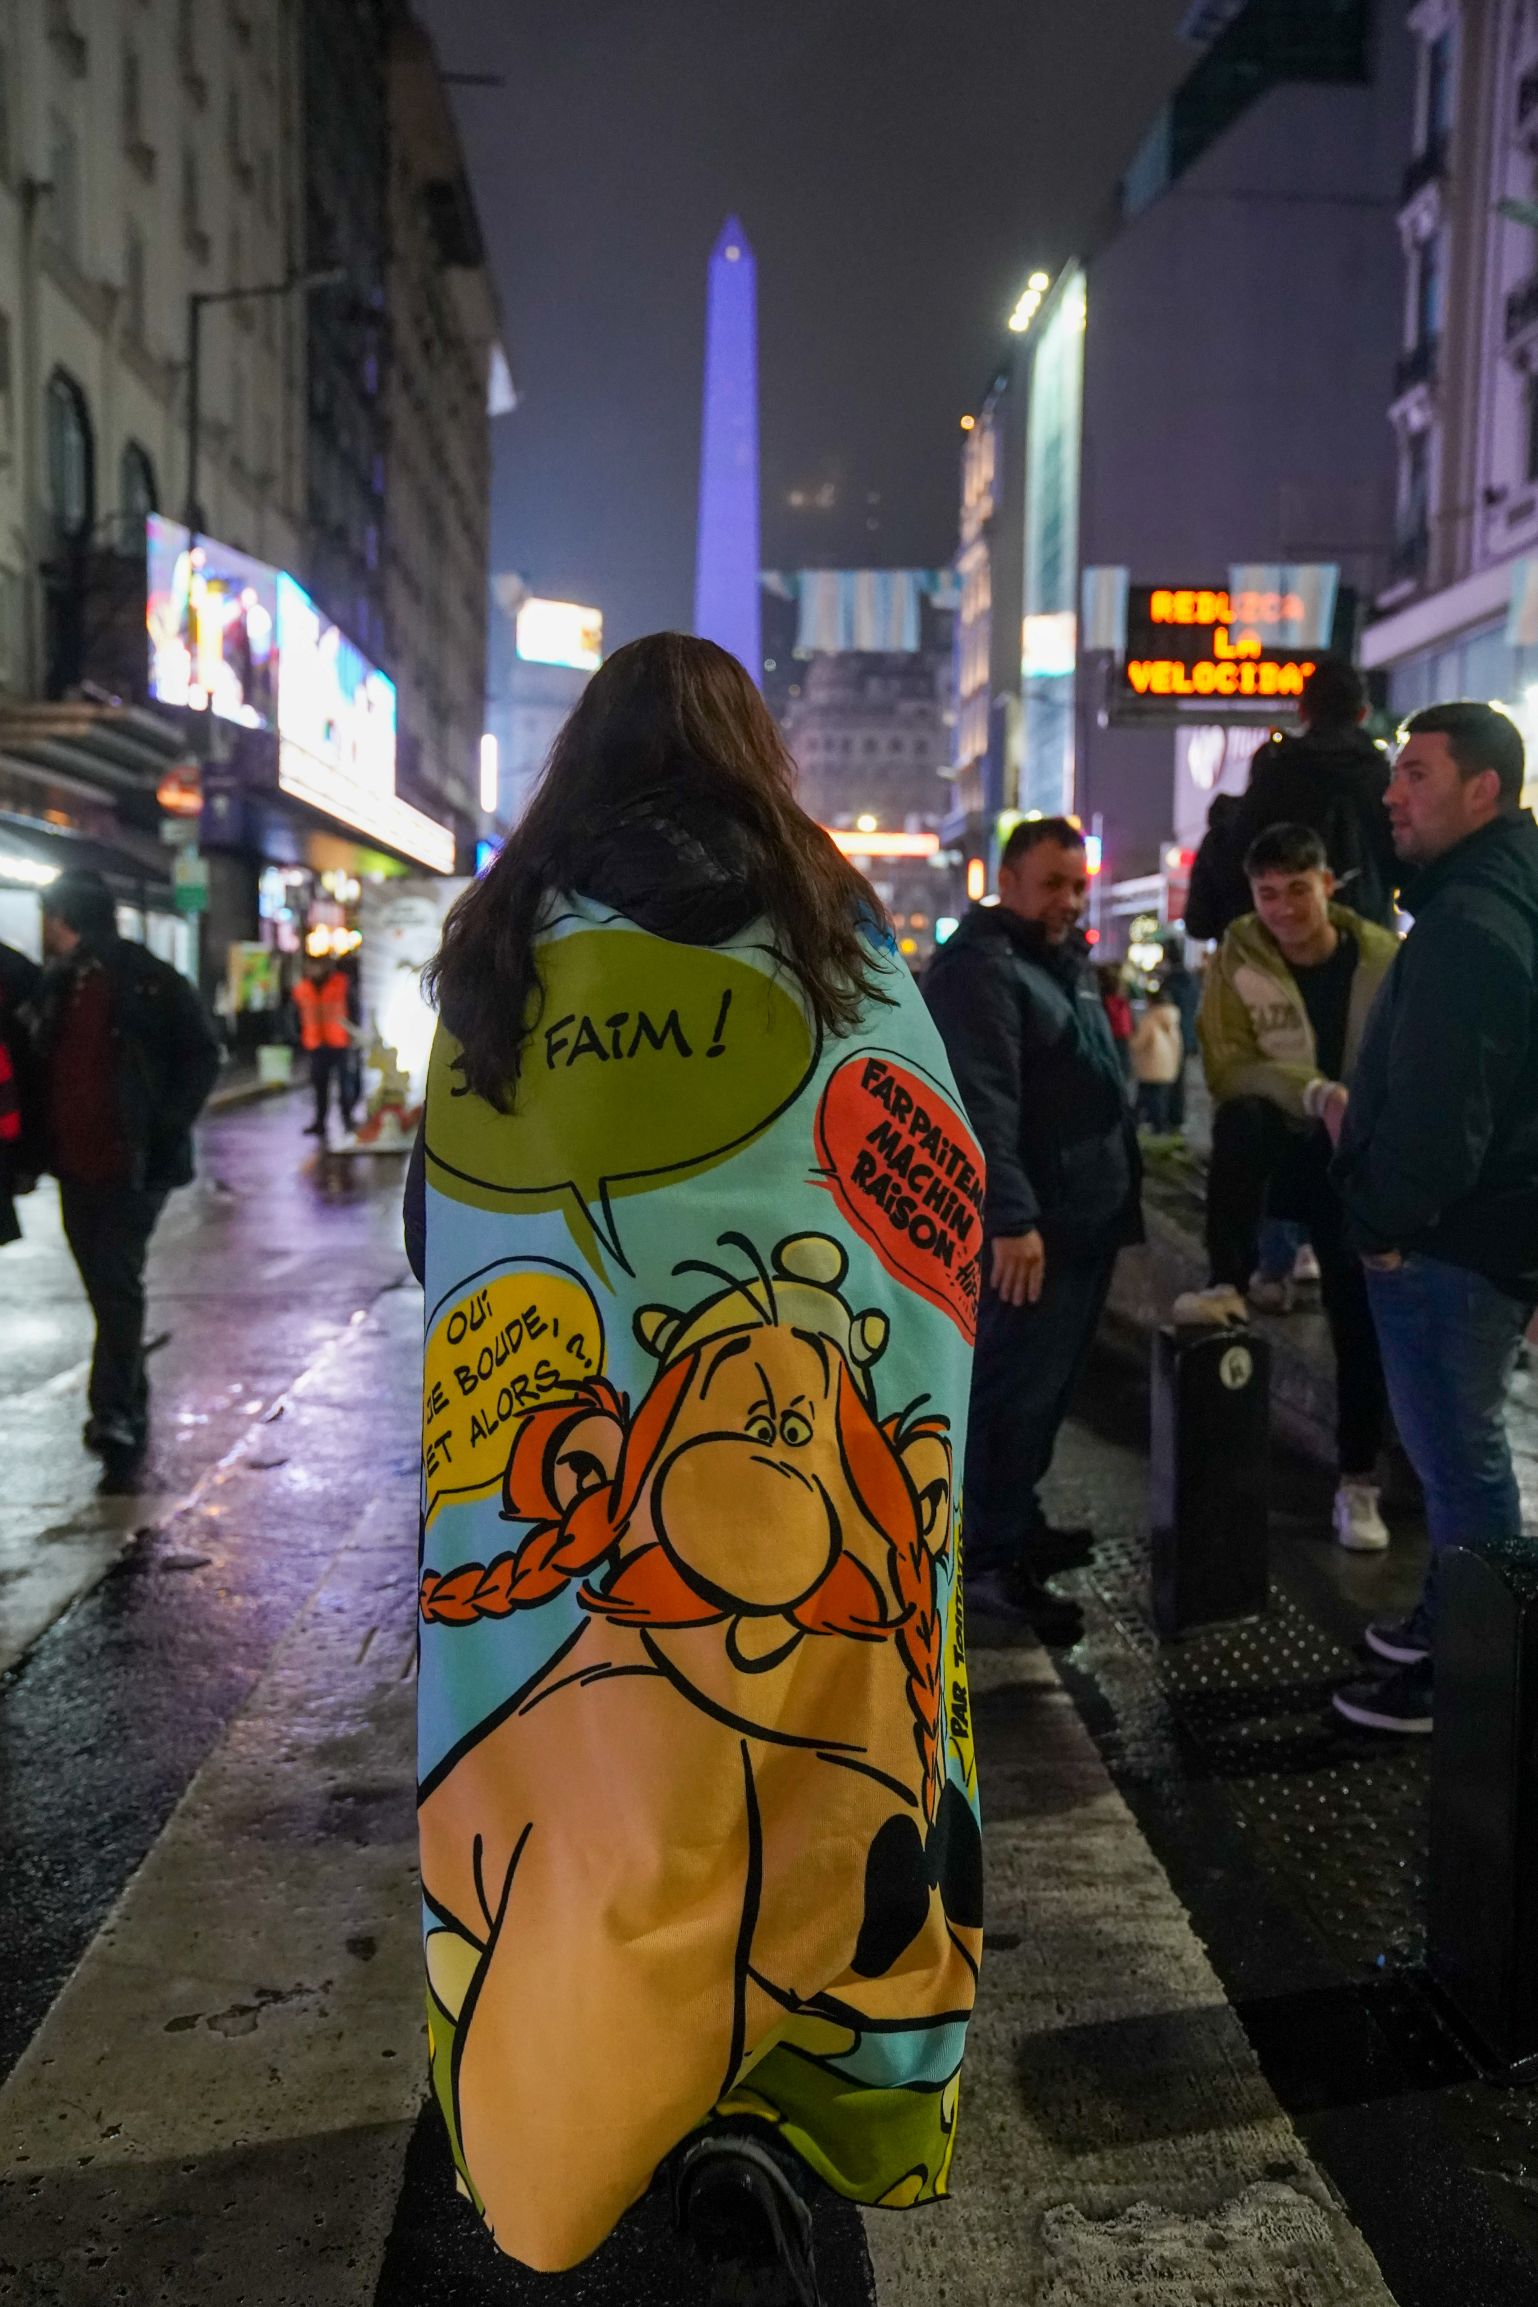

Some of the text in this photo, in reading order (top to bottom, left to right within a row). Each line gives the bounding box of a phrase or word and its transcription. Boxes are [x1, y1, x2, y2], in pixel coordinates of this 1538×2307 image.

[1214, 626, 1262, 660] LA
[1127, 660, 1316, 695] VELOCIDA
[426, 1430, 452, 1478] ET
[470, 1360, 560, 1448] ALORS
[950, 1681, 969, 1740] PAR
